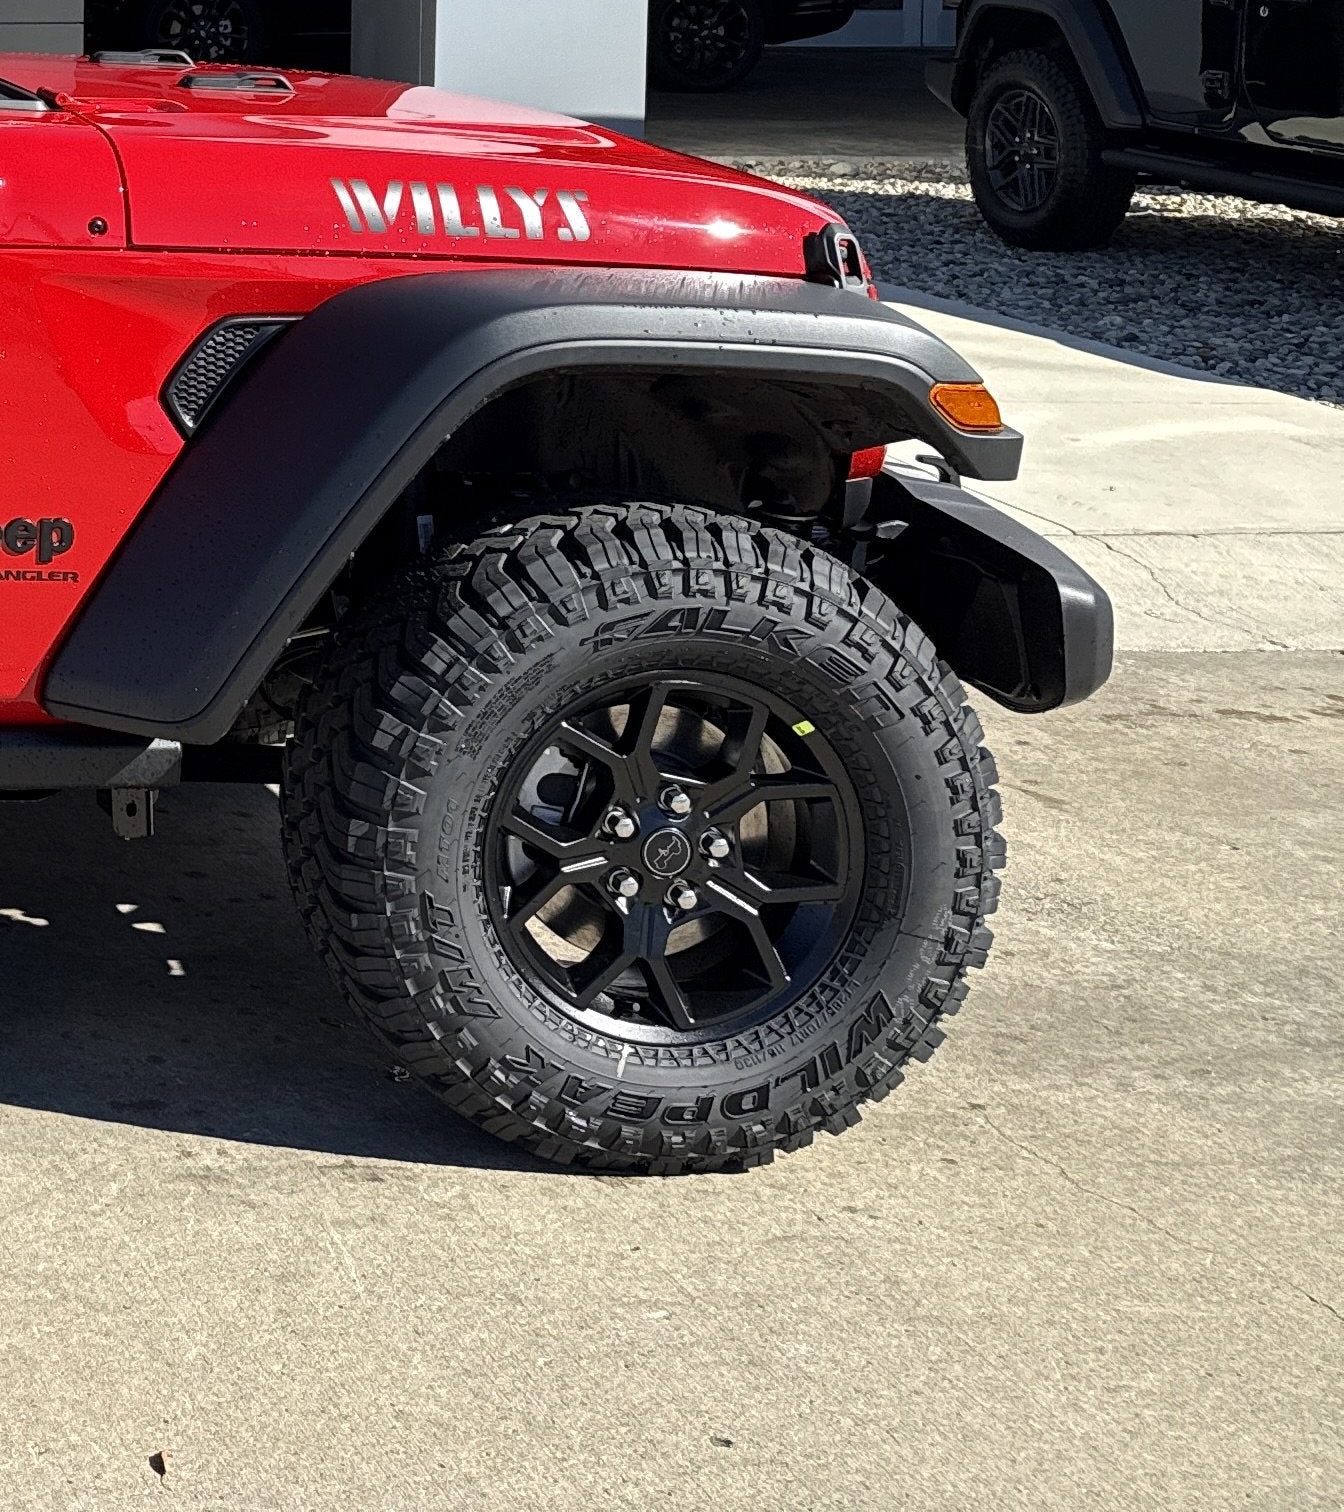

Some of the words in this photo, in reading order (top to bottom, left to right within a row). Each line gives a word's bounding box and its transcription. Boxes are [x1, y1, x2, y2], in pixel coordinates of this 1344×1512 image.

[330, 179, 591, 241] WILLYS
[579, 605, 906, 727] FALKEN
[505, 993, 897, 1123] WILDPEAK
